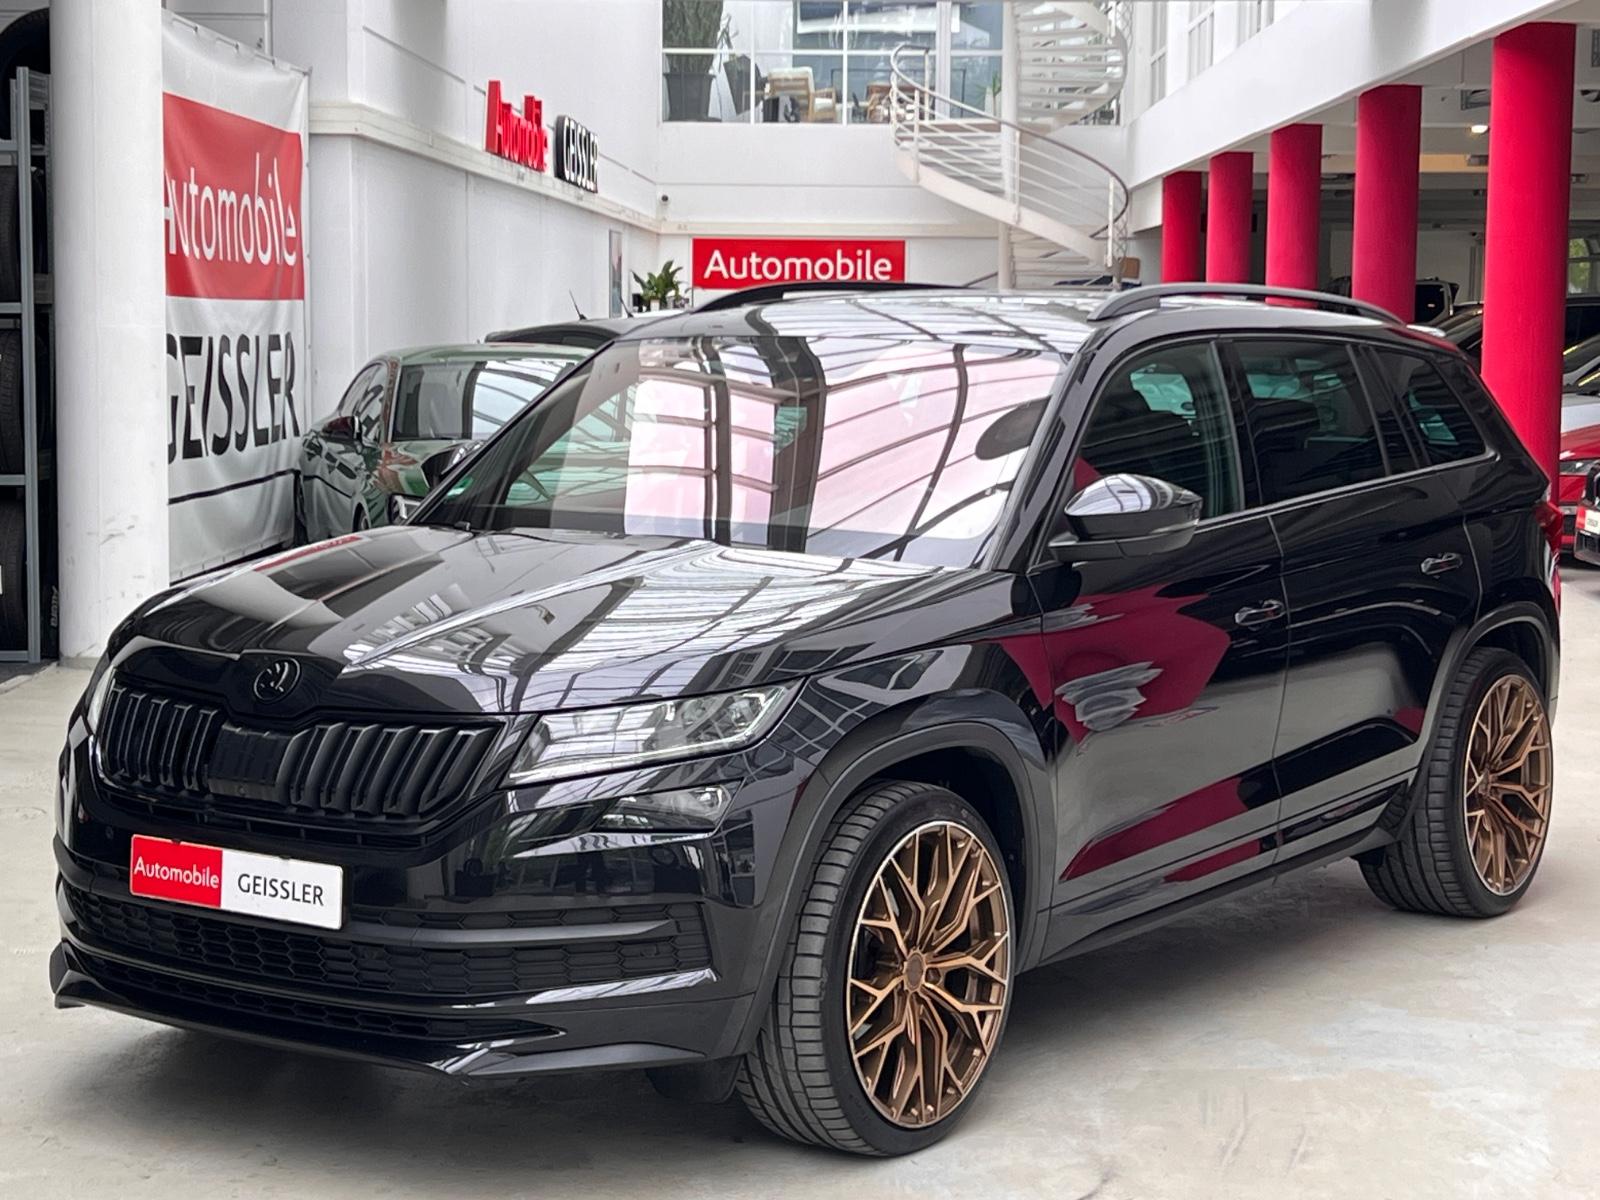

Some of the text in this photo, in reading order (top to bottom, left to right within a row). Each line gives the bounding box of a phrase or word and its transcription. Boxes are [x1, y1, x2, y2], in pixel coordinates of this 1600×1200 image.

[553, 114, 599, 193] GEISSLER
[703, 248, 893, 281] Automobile
[134, 856, 324, 906] Automobile GEISSLER
